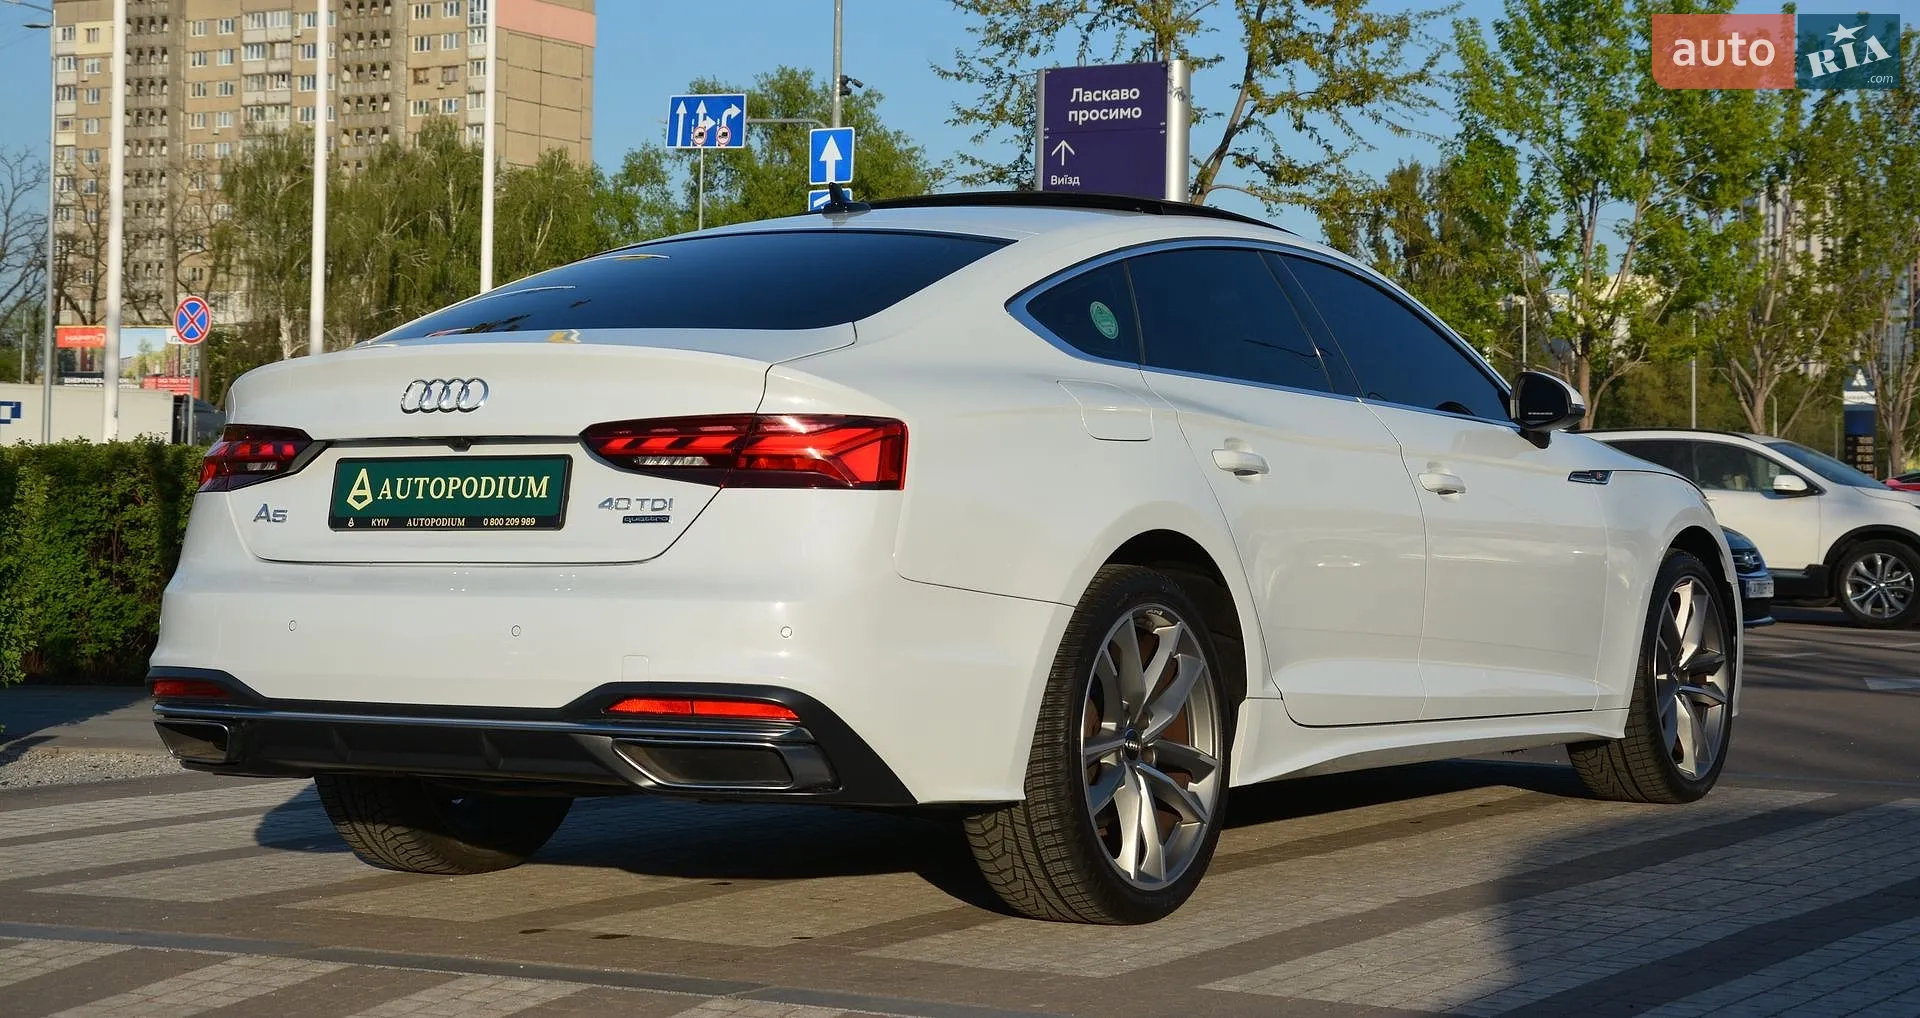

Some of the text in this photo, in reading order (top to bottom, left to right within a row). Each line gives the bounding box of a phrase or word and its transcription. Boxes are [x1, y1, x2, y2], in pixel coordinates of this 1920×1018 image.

[1070, 87, 1140, 103] Ласкаво
[1068, 107, 1142, 125] просимо
[1050, 175, 1080, 187] Виїзд
[377, 475, 551, 500] AUTOPODIUM
[598, 497, 673, 511] 40 TDI
[253, 503, 288, 524] A5
[624, 515, 669, 524] quattro
[371, 517, 535, 528] KYIV AUTOPODIUM 0 800 209 989
